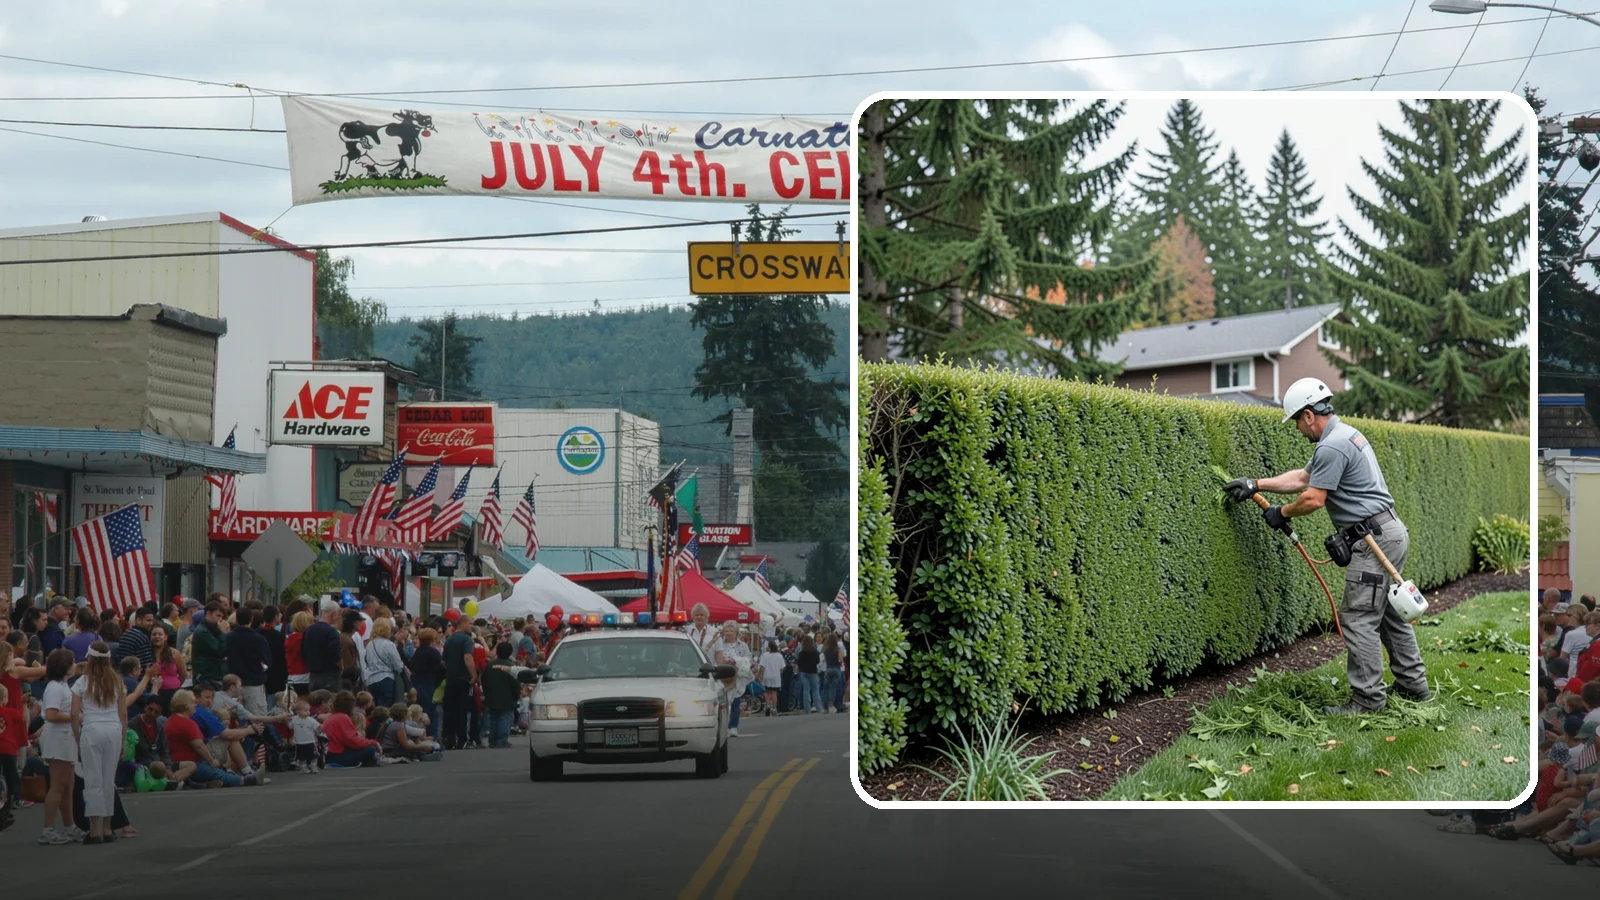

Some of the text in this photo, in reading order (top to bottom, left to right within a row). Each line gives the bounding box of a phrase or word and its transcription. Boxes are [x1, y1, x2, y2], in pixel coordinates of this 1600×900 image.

[481, 141, 605, 192] JULY
[632, 150, 746, 197] 4th.
[697, 254, 850, 279] CROSSWA
[283, 380, 373, 420] ACE
[406, 409, 452, 422] CEDAR
[284, 421, 370, 436] Hardware
[353, 467, 386, 480] Simpl
[95, 485, 124, 495] Vincent
[126, 485, 136, 495] de
[137, 486, 155, 495] Paul
[212, 516, 331, 535] HARDARE
[688, 526, 742, 535] CRNATION
[699, 535, 730, 543] GLASS
